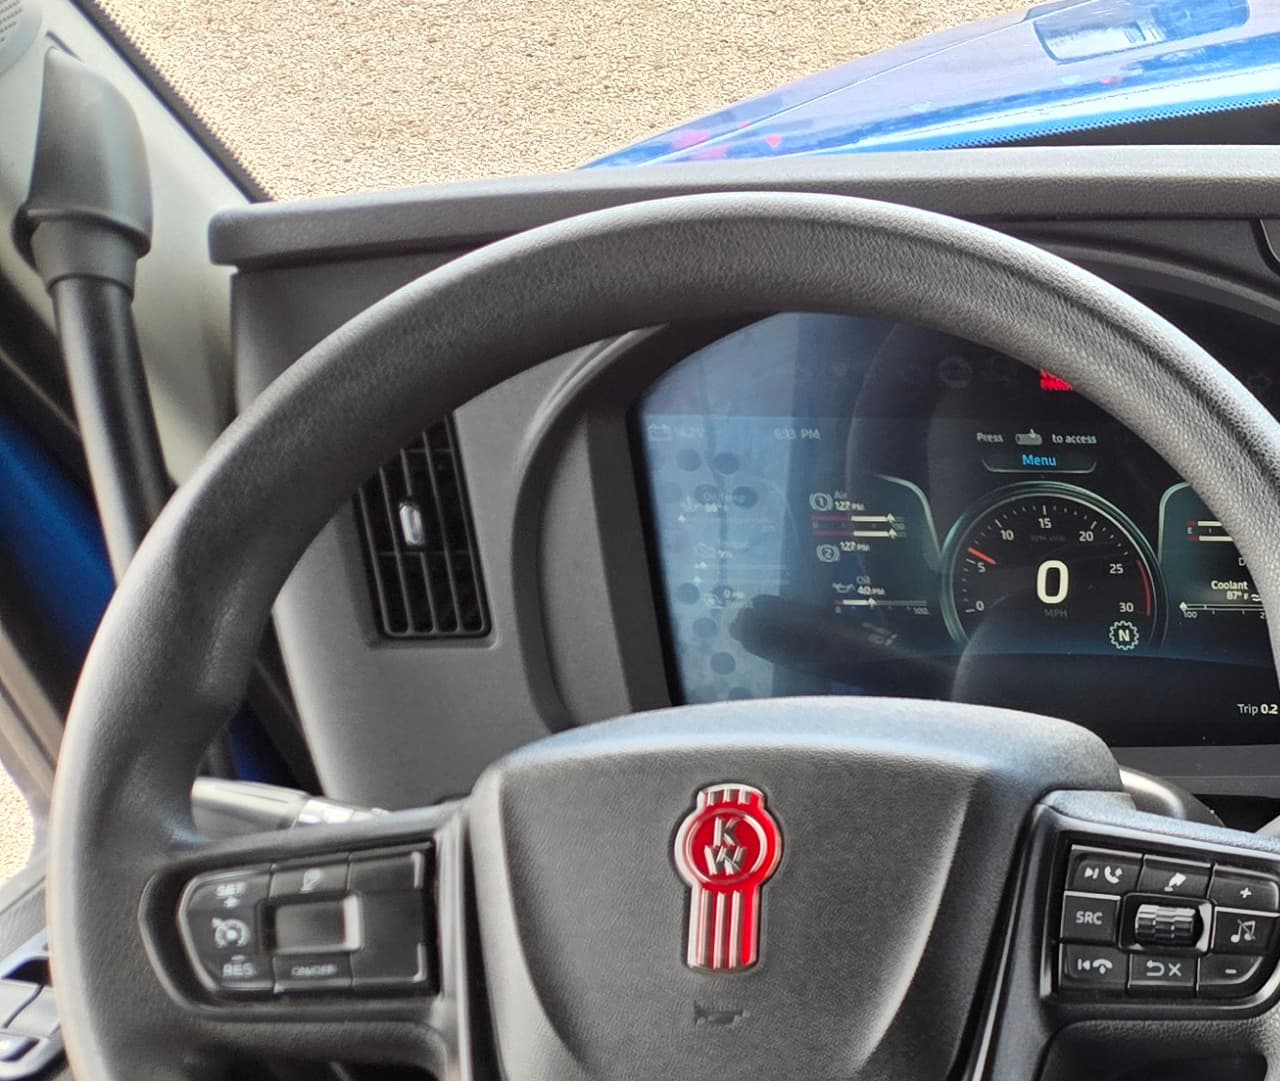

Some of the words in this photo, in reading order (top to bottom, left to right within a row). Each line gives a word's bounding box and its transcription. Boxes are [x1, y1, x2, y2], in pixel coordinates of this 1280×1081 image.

[976, 432, 1004, 443] Press
[1052, 434, 1063, 444] to
[1065, 435, 1097, 444] access
[1022, 454, 1057, 467] Menu
[1038, 517, 1052, 529] 15
[1000, 530, 1014, 541] 10
[1079, 531, 1094, 542] 20
[977, 563, 986, 573] 5
[1109, 563, 1124, 574] 25
[1036, 559, 1070, 604] 0
[1211, 580, 1248, 590] Coolant
[976, 600, 985, 611] 0
[1119, 602, 1134, 613] 30
[1044, 608, 1068, 617] MPH
[1118, 629, 1130, 641] N
[1238, 703, 1258, 715] Trip
[1260, 703, 1278, 715] 0.2
[216, 882, 246, 897] SET
[1075, 911, 1103, 925] SRC
[223, 963, 254, 976] RES
